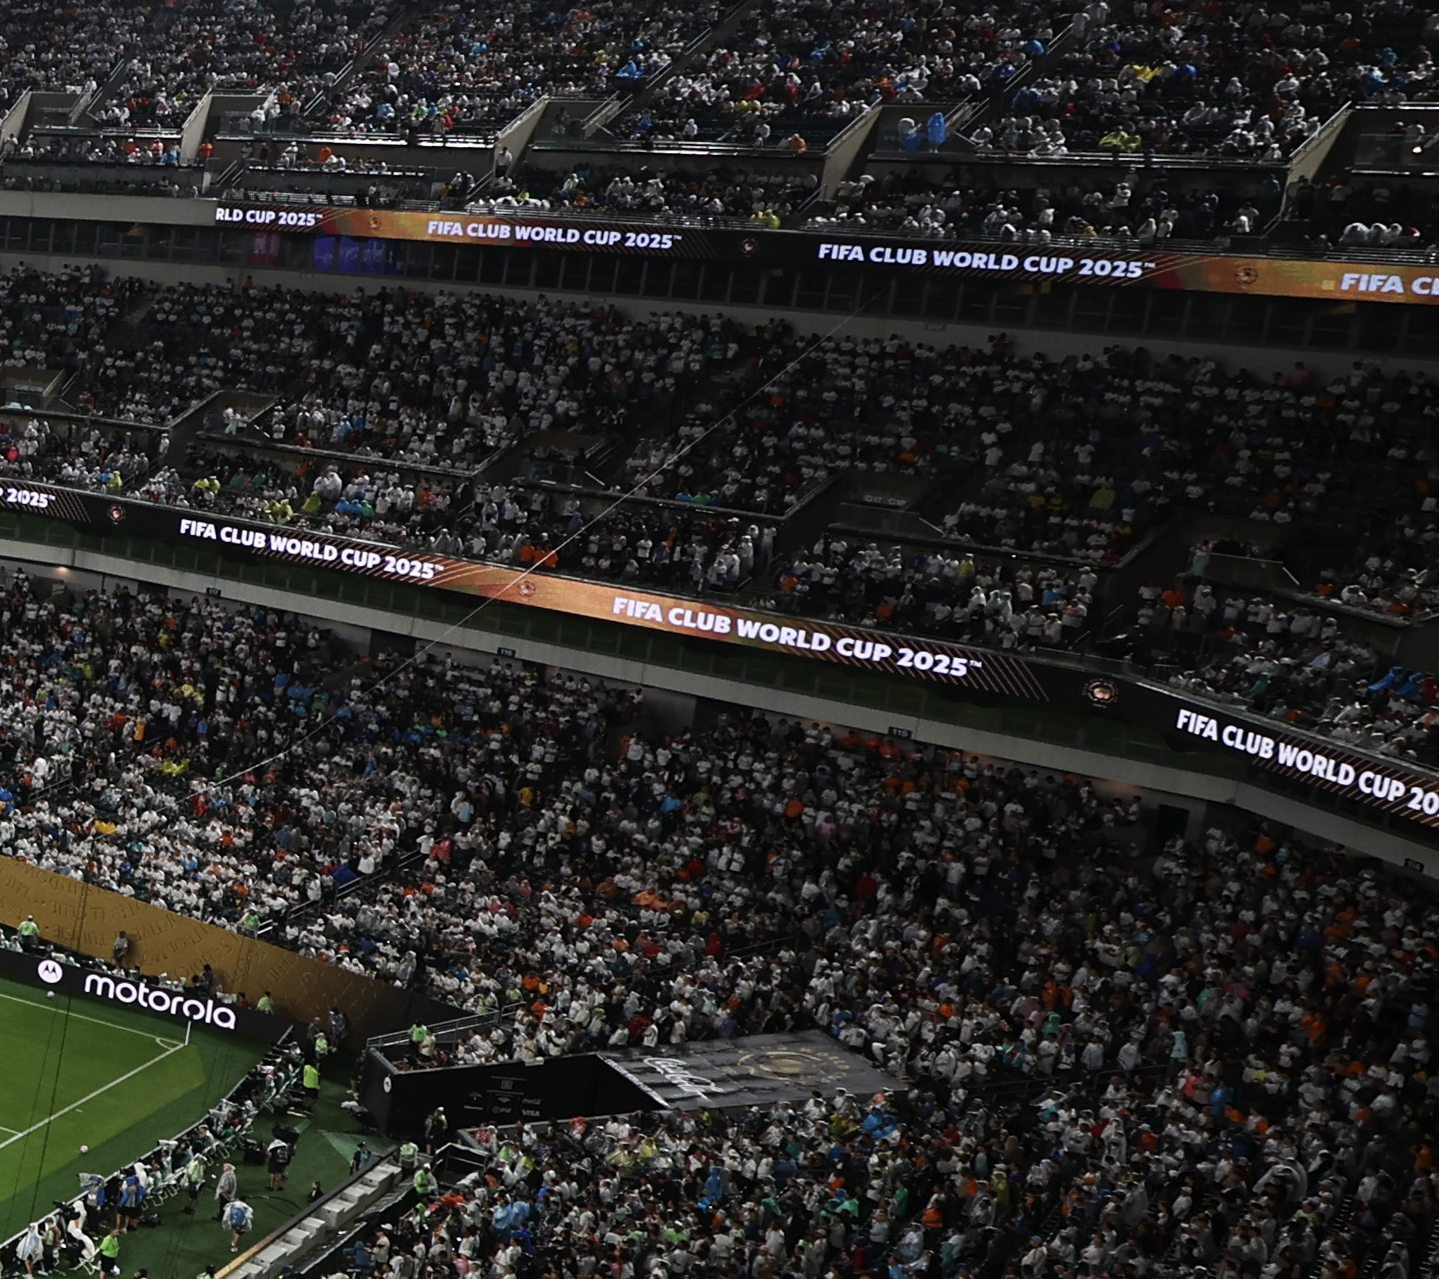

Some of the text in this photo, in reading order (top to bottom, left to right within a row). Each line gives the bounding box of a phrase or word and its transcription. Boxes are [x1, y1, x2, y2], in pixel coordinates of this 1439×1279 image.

[245, 209, 276, 224] CUP
[426, 220, 464, 237] FIFA
[466, 222, 511, 239] CLUB
[515, 225, 580, 243] WORLD
[583, 229, 622, 246] CUP
[818, 243, 864, 261] FIFA
[869, 247, 927, 265] CLUB
[933, 250, 1019, 270] WORLD
[1023, 256, 1074, 274] CUP
[1340, 273, 1404, 294] FIFA
[180, 518, 217, 540] FIFA
[220, 526, 267, 548] CLUB
[270, 534, 338, 562] WORLD
[340, 548, 382, 569] CUP
[612, 596, 663, 622] FIFA
[668, 607, 731, 633] CLUB
[737, 618, 831, 651] WORLD
[836, 637, 892, 661] CUP
[1176, 709, 1439, 815] FIFA CLUB WORLD CUP 20
[84, 972, 237, 1031] motorola
